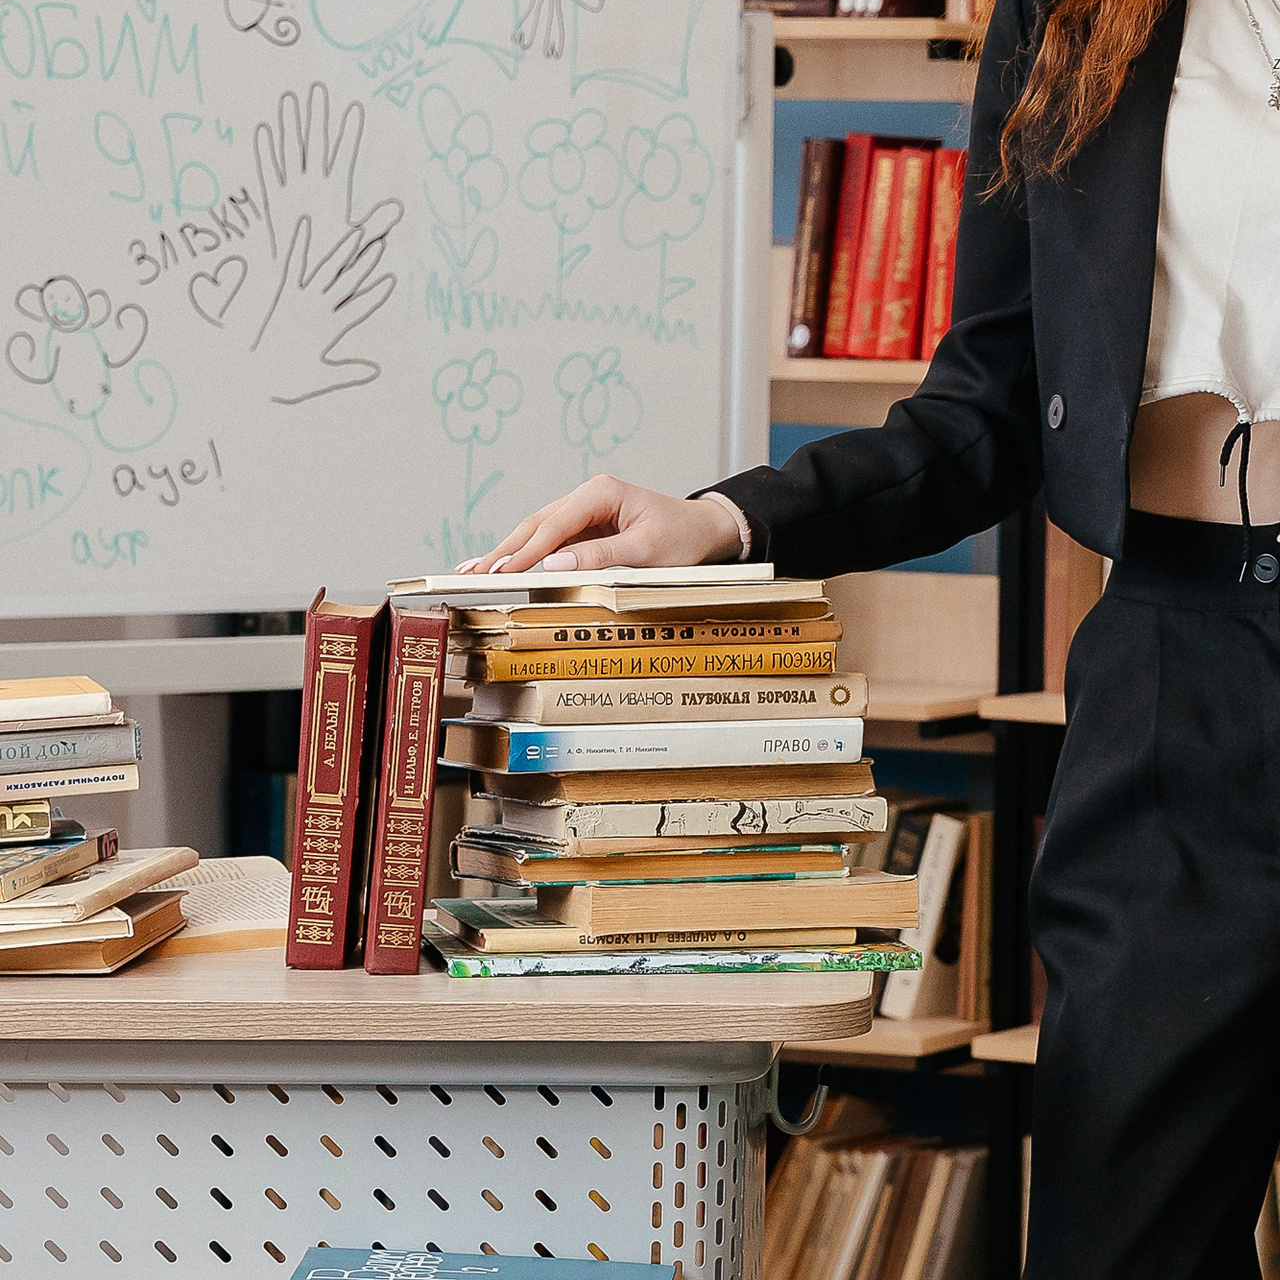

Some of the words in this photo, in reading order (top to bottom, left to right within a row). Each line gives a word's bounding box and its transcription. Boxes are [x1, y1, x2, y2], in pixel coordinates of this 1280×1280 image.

[554, 626, 694, 642] РЕВИЗОР
[568, 656, 624, 677] ЗАЧЕМ
[630, 657, 643, 675] И
[649, 656, 697, 675] КОМУ
[704, 653, 764, 673] НУЖНА
[772, 650, 832, 670] ПОЭЗИЯ
[410, 680, 424, 727] ПЕТРОВ
[556, 690, 613, 709] ЛЕОНИД
[618, 690, 674, 707] ИВАНОВ
[680, 689, 750, 707] ГЛУБОКАЯ
[757, 688, 817, 705] БОРОЗДА
[328, 700, 340, 751] БЕЛЫЙ
[37, 742, 78, 759] ДОМ
[526, 745, 542, 761] 10
[545, 745, 560, 759] 11
[634, 744, 668, 754] Никитина
[763, 738, 811, 754] ПРАВО
[6, 778, 66, 791] РАЗРАБОТКИ
[68, 774, 125, 785] ПОУРОЧНЫЕ
